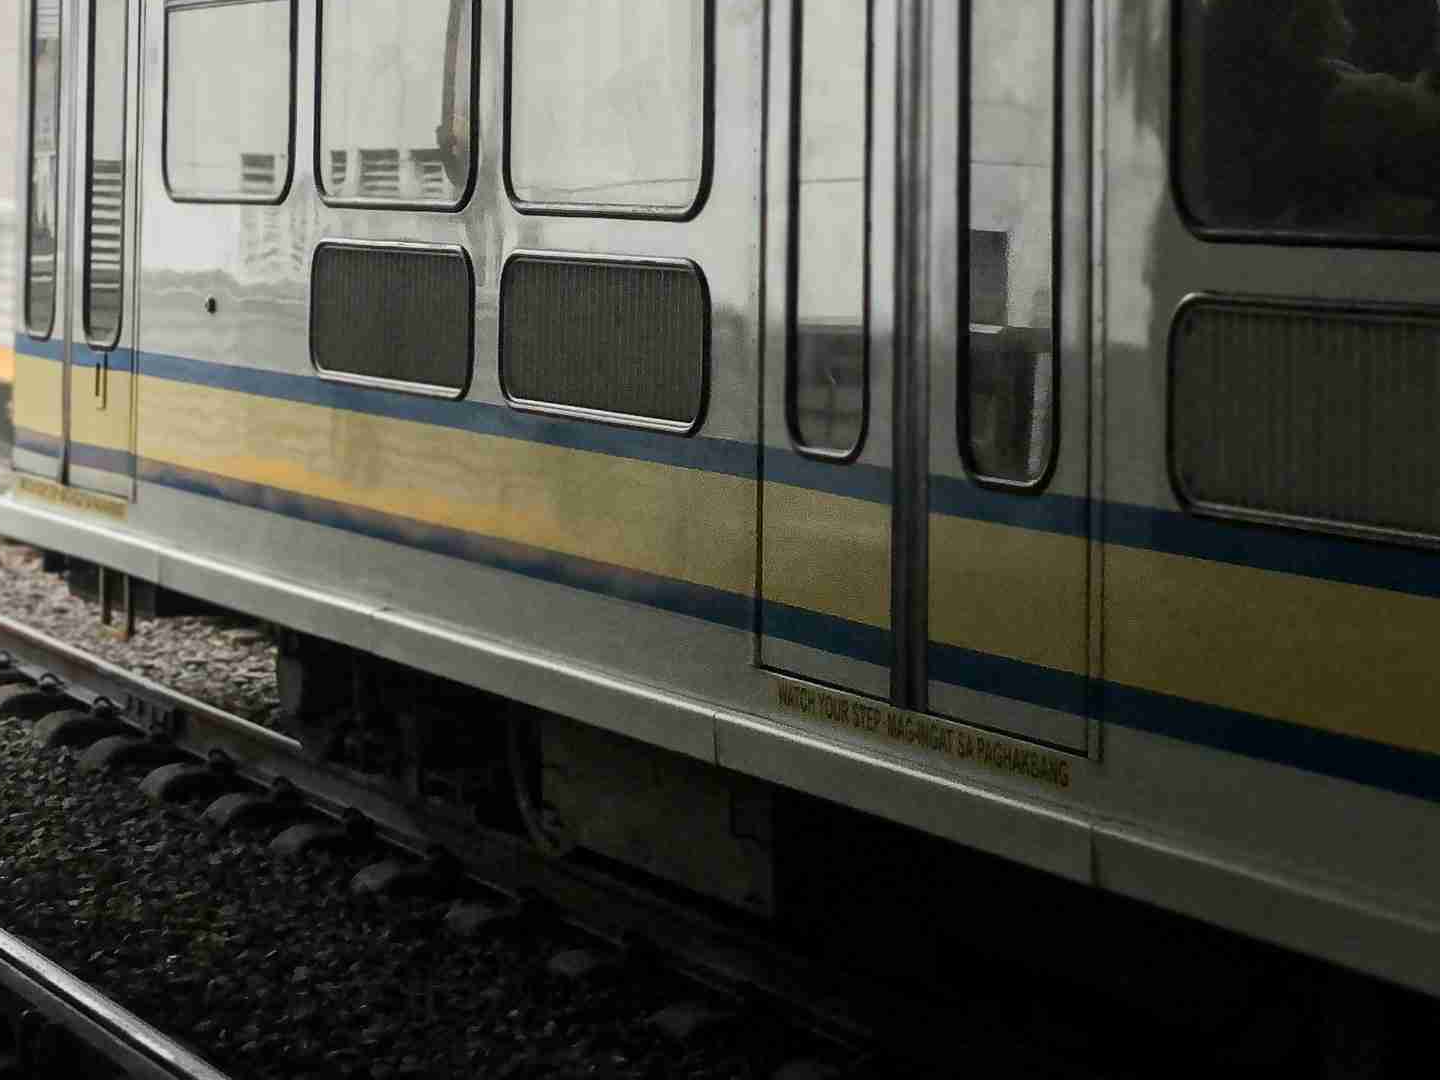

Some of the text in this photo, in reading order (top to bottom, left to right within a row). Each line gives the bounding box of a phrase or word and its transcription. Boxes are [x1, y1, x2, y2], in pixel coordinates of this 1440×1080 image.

[776, 681, 816, 718] WATCH
[817, 692, 850, 726] YOUR
[852, 701, 881, 732] STEP
[958, 731, 974, 759] SA
